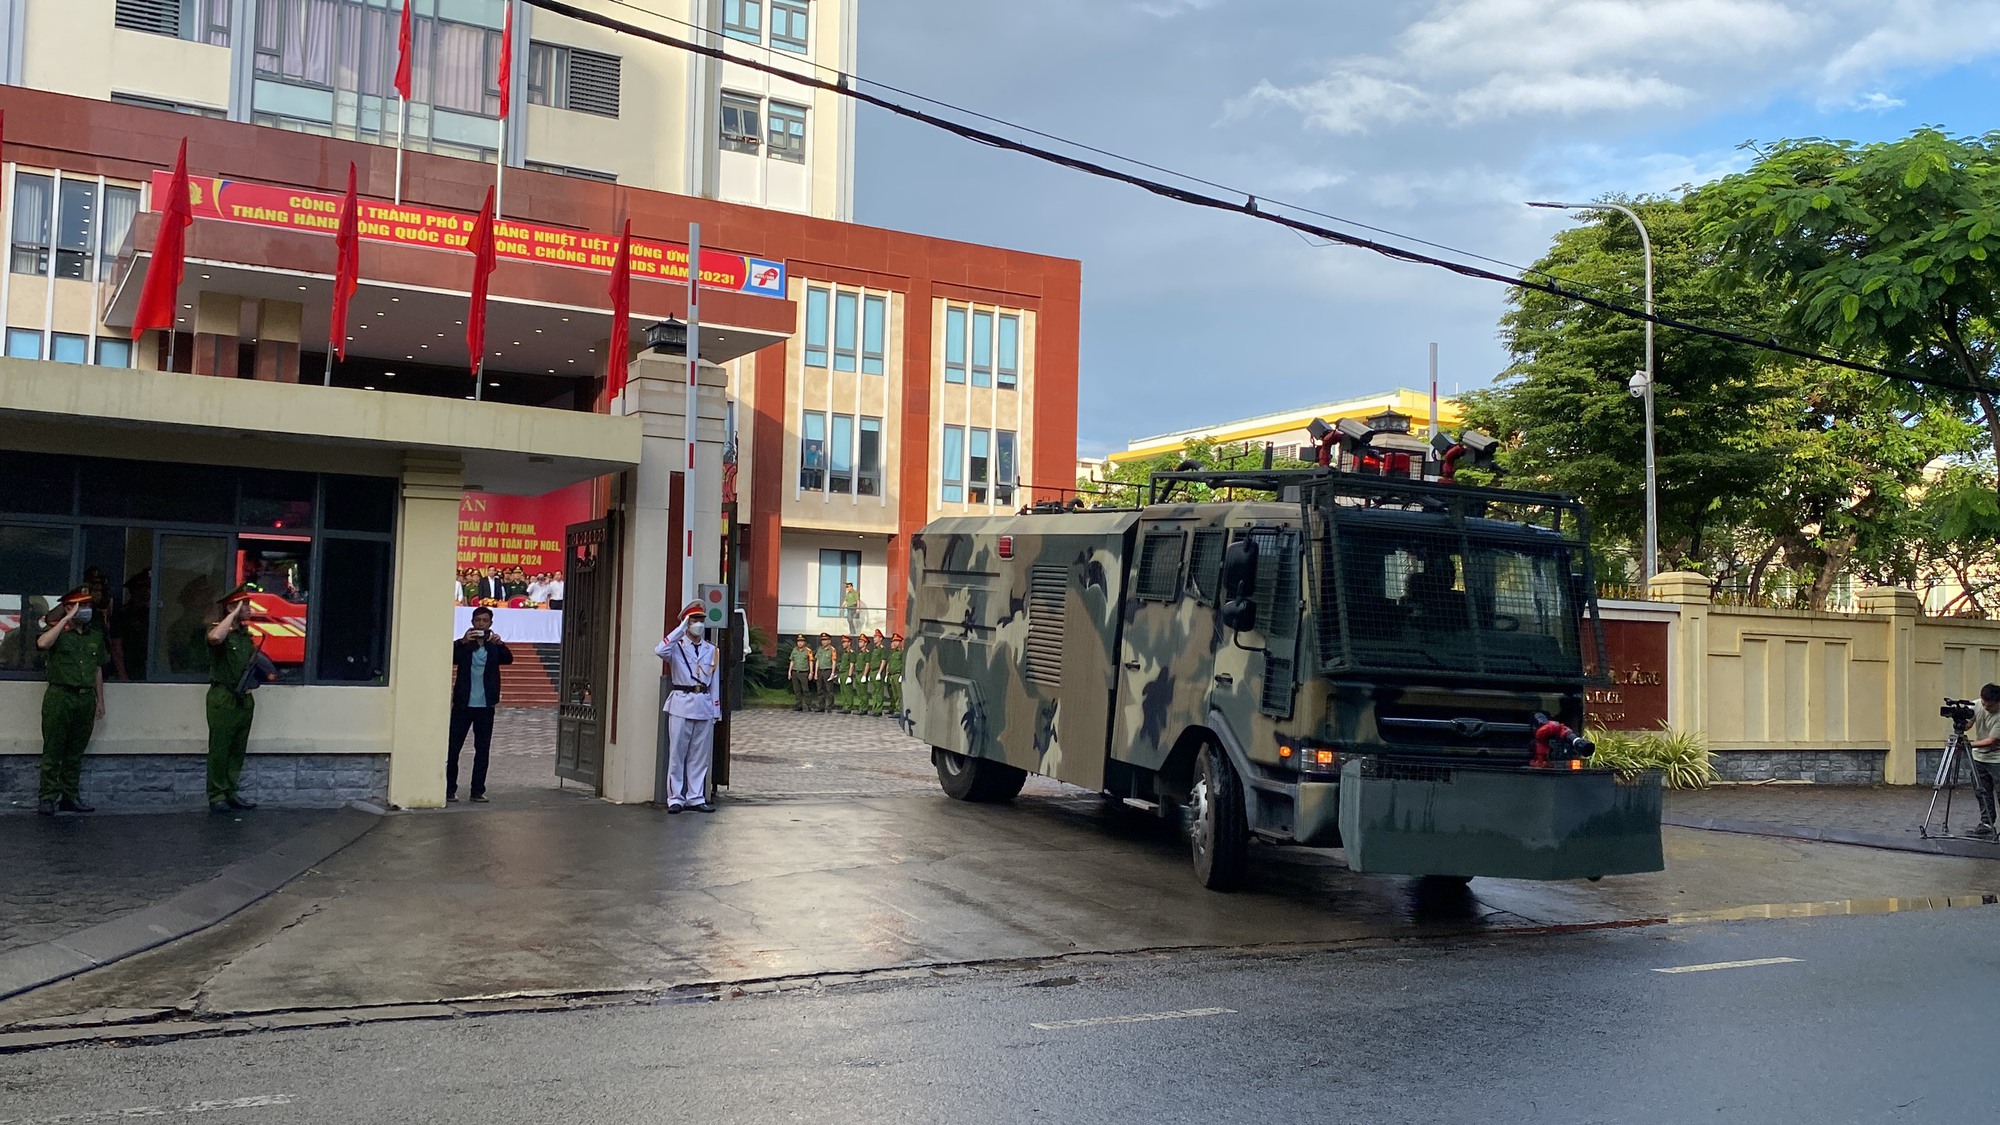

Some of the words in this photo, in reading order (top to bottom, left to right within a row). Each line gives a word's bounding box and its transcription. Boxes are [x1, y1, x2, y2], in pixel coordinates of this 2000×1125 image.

[290, 196, 336, 213] CÔNG
[367, 206, 421, 225] THÀNH
[426, 216, 458, 230] PHỐ
[534, 230, 577, 247] NHIỆT
[581, 238, 610, 252] LIỆT
[231, 203, 288, 223] THÁNG
[294, 212, 339, 230] HÀNH
[357, 219, 390, 236] ỘNG
[395, 226, 439, 243] QUỐC
[444, 233, 469, 247] GIA
[496, 239, 530, 256] ÒNG,
[535, 245, 587, 263] CHỐNG
[661, 264, 689, 278] NĂM
[699, 271, 735, 285] 2023!
[462, 495, 486, 512] ÂN
[482, 520, 494, 532] ÁP
[495, 521, 509, 535] TỘI
[511, 524, 536, 536] PHẠM,
[458, 535, 469, 549] ỆT
[488, 538, 498, 548] AN
[501, 538, 522, 549] TOÀN
[524, 540, 538, 551] DỊP
[540, 540, 561, 552] NOEL,
[457, 551, 477, 562] GIÁP
[479, 552, 498, 563] THÌN
[500, 553, 519, 564] NĂM
[521, 555, 542, 565] 2024
